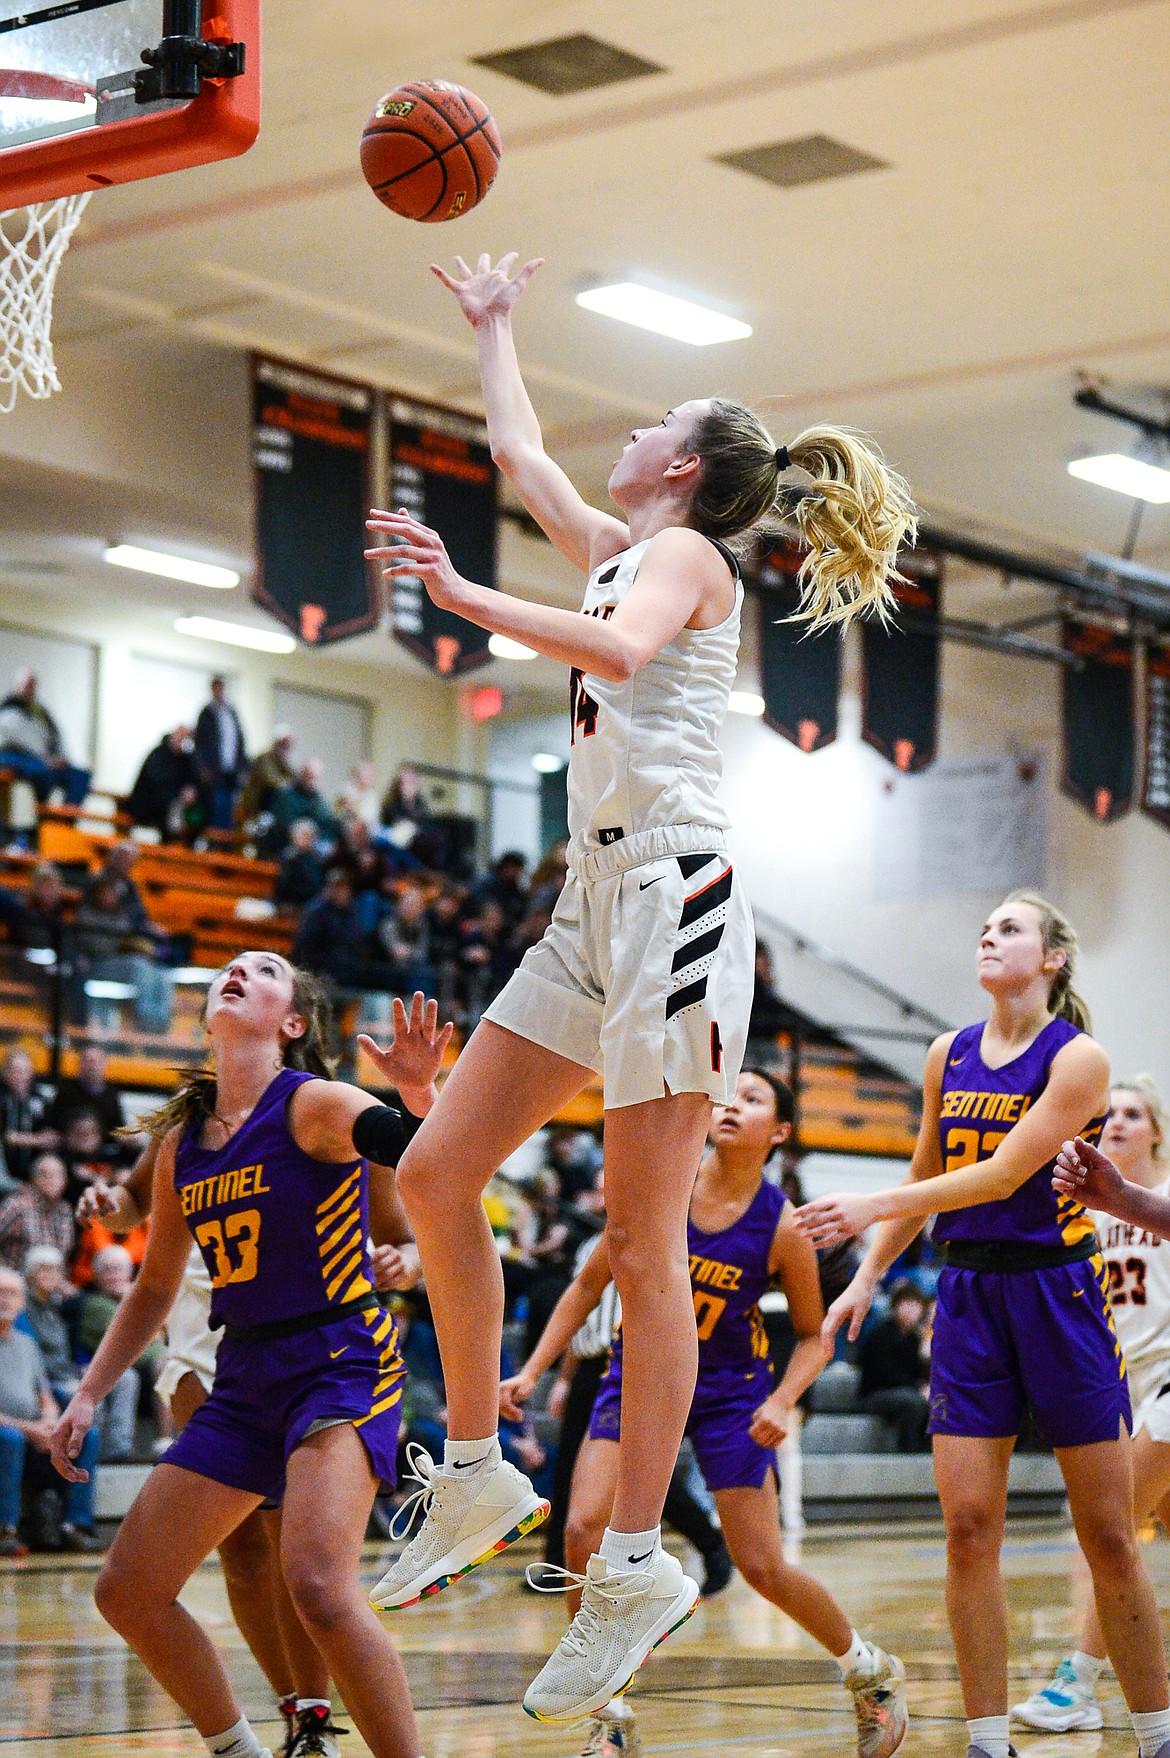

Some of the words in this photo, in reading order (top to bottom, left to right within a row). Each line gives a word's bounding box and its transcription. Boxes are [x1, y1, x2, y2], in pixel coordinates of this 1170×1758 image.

[606, 832, 616, 843] M
[946, 1128, 1008, 1173] 2
[181, 1164, 271, 1216] ENTINEL
[195, 1209, 261, 1289] 33
[688, 1254, 743, 1291] TINEL
[1108, 1256, 1147, 1306] 23
[693, 1290, 727, 1341] 0
